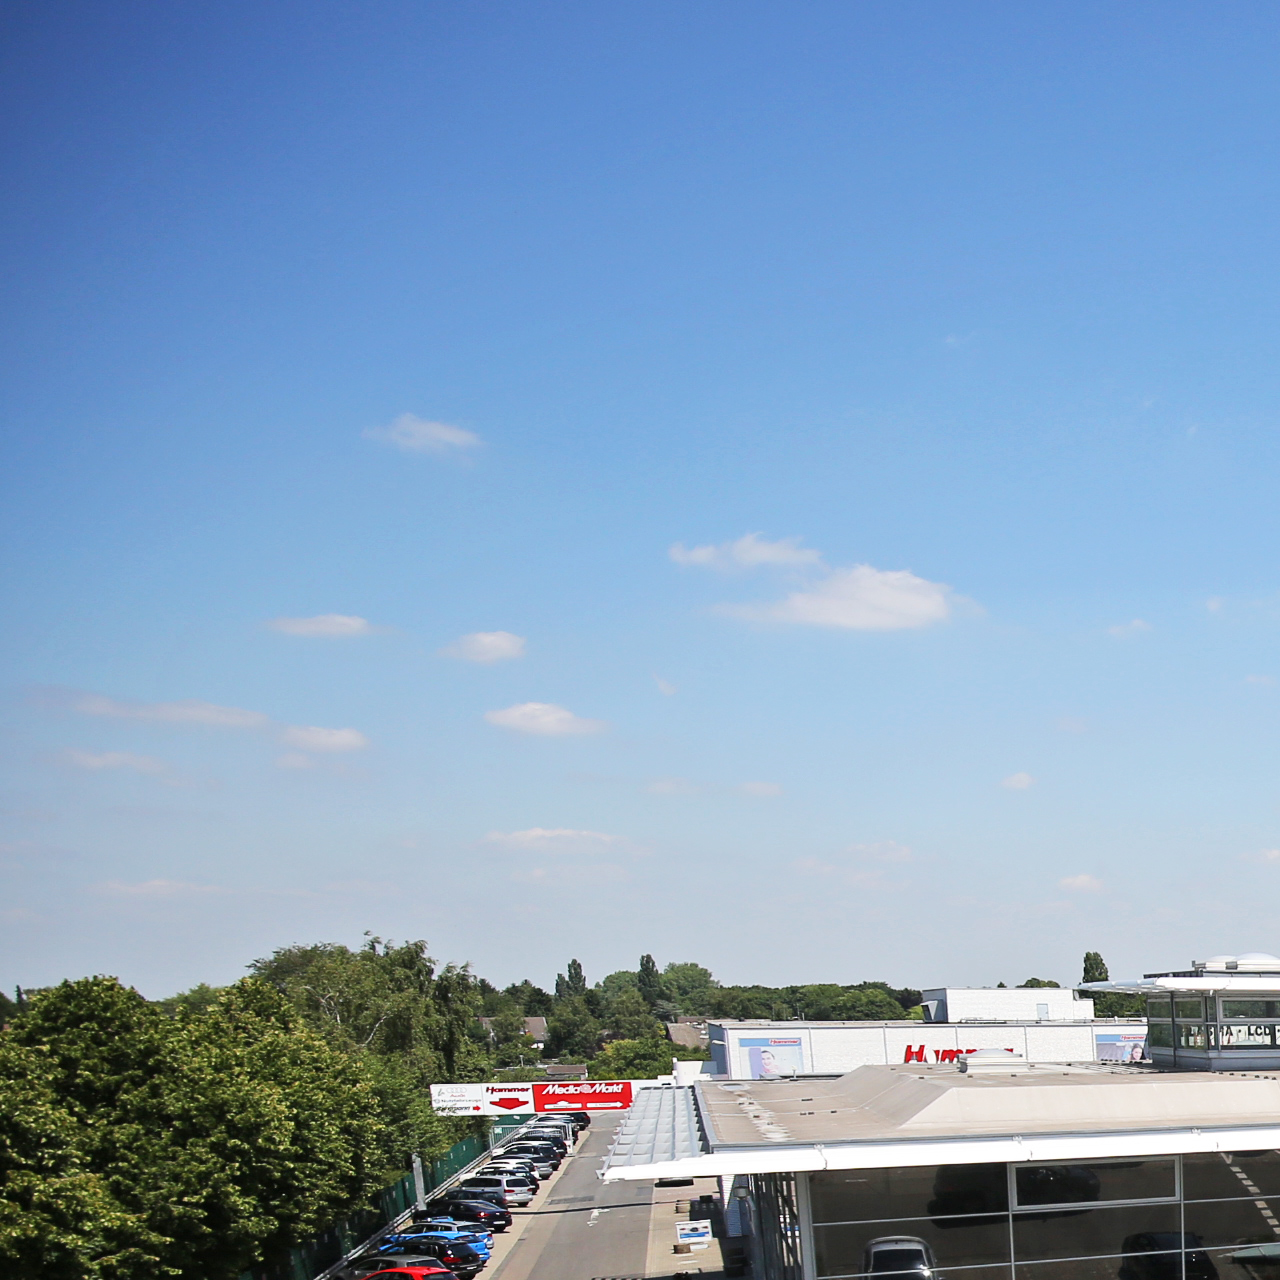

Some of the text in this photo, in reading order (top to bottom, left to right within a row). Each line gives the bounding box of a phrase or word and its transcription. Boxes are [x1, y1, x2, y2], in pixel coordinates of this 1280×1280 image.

[486, 1086, 530, 1095] Hammer
[542, 1083, 624, 1095] Media Markt
